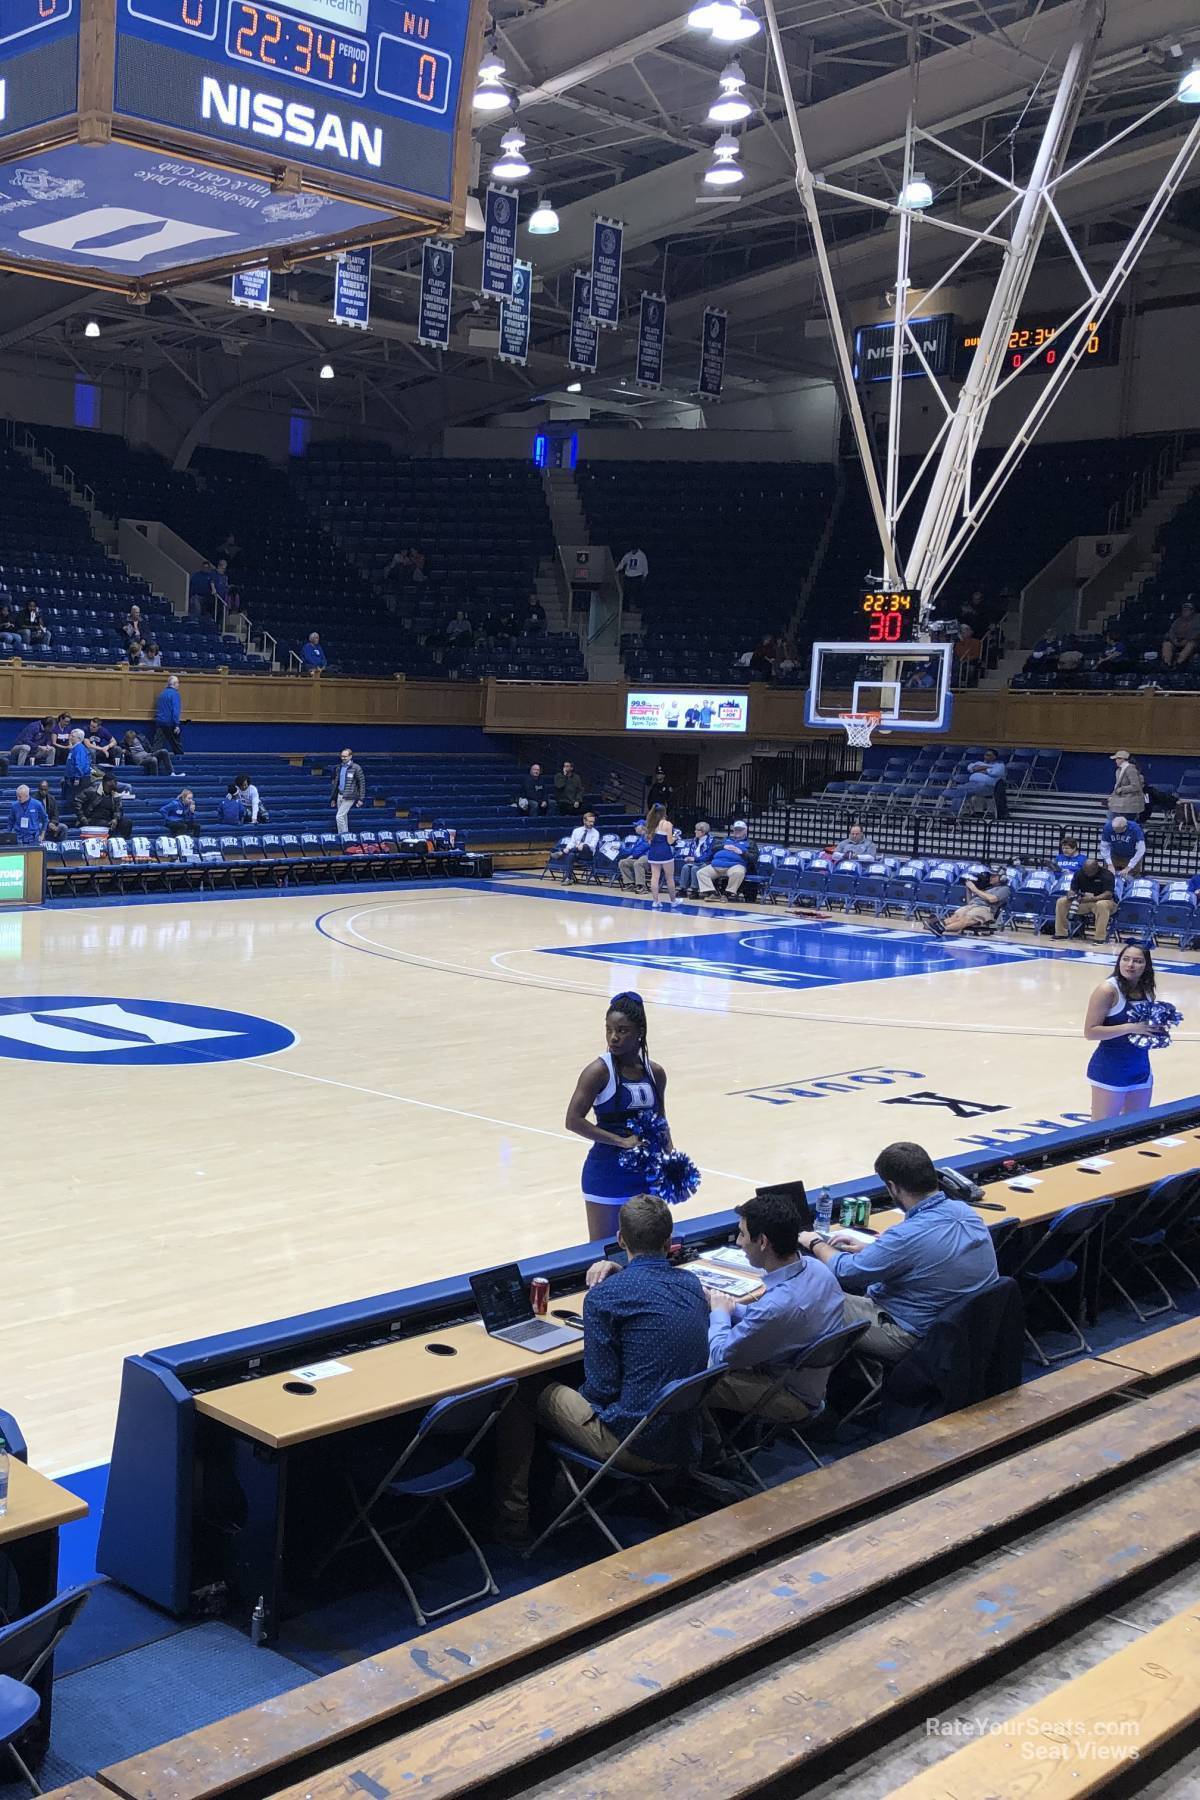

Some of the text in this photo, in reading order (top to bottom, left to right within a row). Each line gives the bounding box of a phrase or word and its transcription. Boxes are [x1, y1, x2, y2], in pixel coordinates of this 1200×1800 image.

[404, 11, 429, 39] NU
[237, 6, 337, 80] 22:34
[338, 42, 366, 62] PERIOD
[416, 54, 437, 101] 0
[201, 76, 383, 168] NISSAN
[158, 162, 191, 177] Club
[134, 170, 260, 209] Washington Duke
[248, 181, 273, 198] Inn
[1008, 327, 1057, 348] 22:34
[863, 594, 912, 612] 22:34
[868, 612, 903, 641] 30
